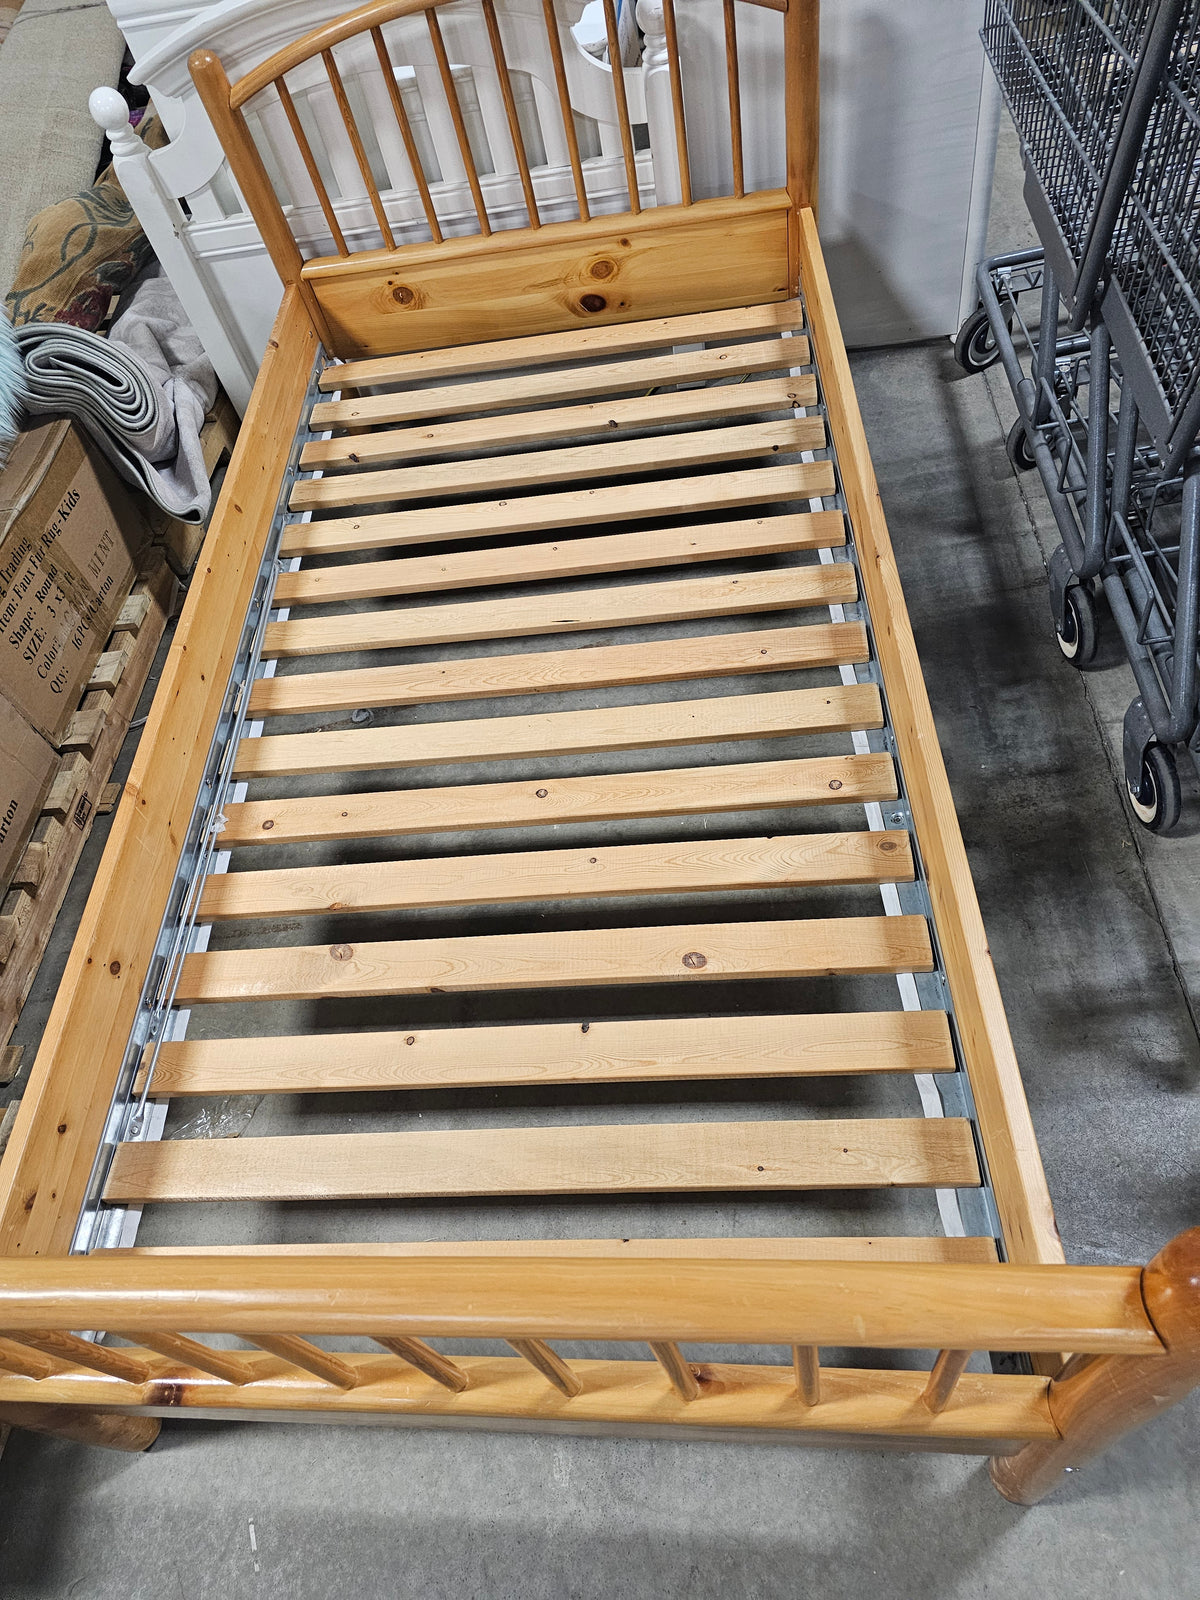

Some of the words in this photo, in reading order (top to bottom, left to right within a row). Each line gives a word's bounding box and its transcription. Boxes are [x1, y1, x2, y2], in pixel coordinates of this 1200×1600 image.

[9, 606, 37, 649] Shape:
[34, 563, 58, 604] Round
[13, 568, 35, 600] Faux
[29, 546, 46, 571] Fur
[37, 639, 61, 679] Color:
[87, 529, 115, 579] MINT
[22, 627, 48, 665] SIZE:
[46, 605, 57, 618] 3
[64, 570, 76, 586] ft
[50, 665, 69, 694] Qty:
